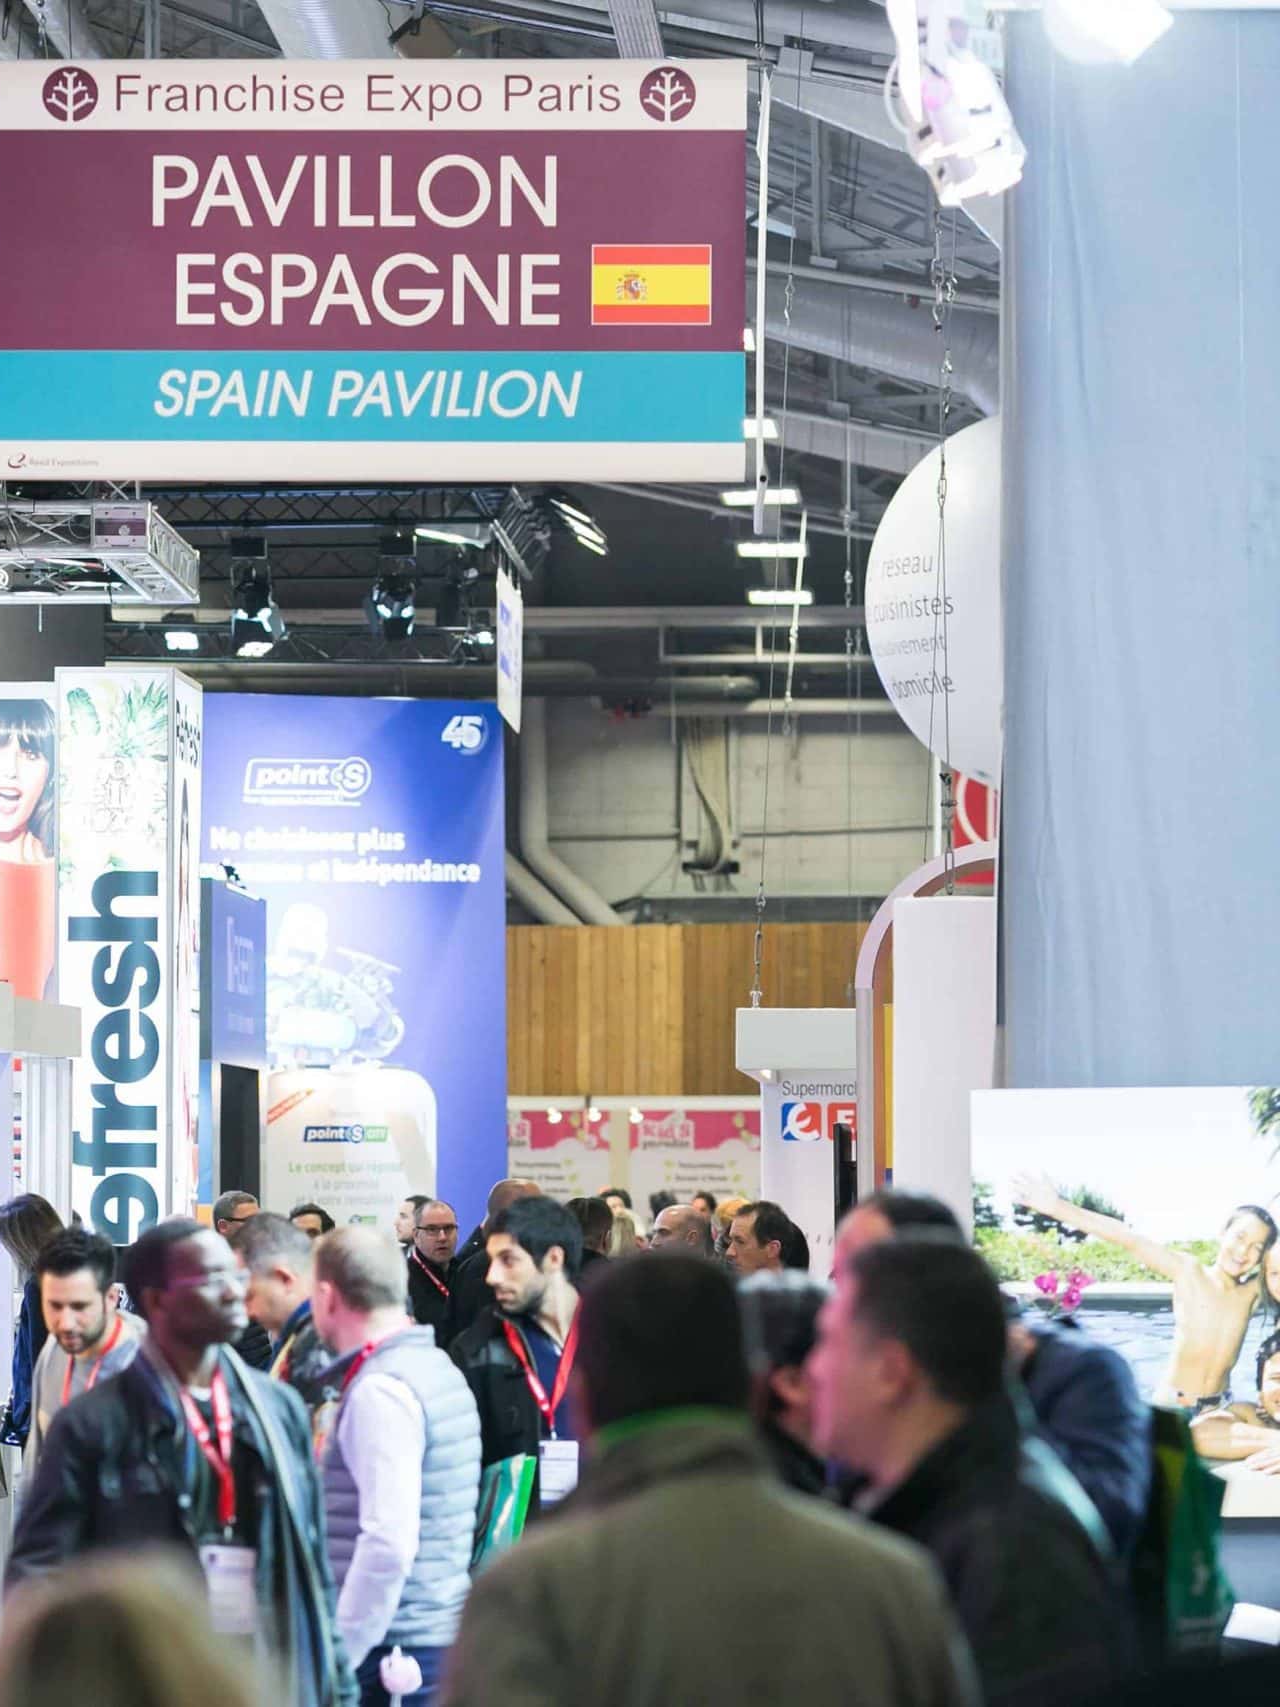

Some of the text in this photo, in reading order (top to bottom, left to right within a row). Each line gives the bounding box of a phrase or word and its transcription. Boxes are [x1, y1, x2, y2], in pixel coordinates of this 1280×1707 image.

[115, 73, 621, 121] Franchise Expo Paris
[152, 154, 558, 229] PAVILLON
[176, 252, 561, 327] ESPAGNE
[153, 369, 583, 418] SPAIN PAVILION
[873, 593, 955, 624] cuisinistes
[891, 670, 957, 699] domicile
[440, 715, 484, 750] 45
[256, 762, 366, 791] point S
[357, 828, 406, 855] plus
[781, 1080, 856, 1098] Supermarc
[306, 1127, 346, 1141] point
